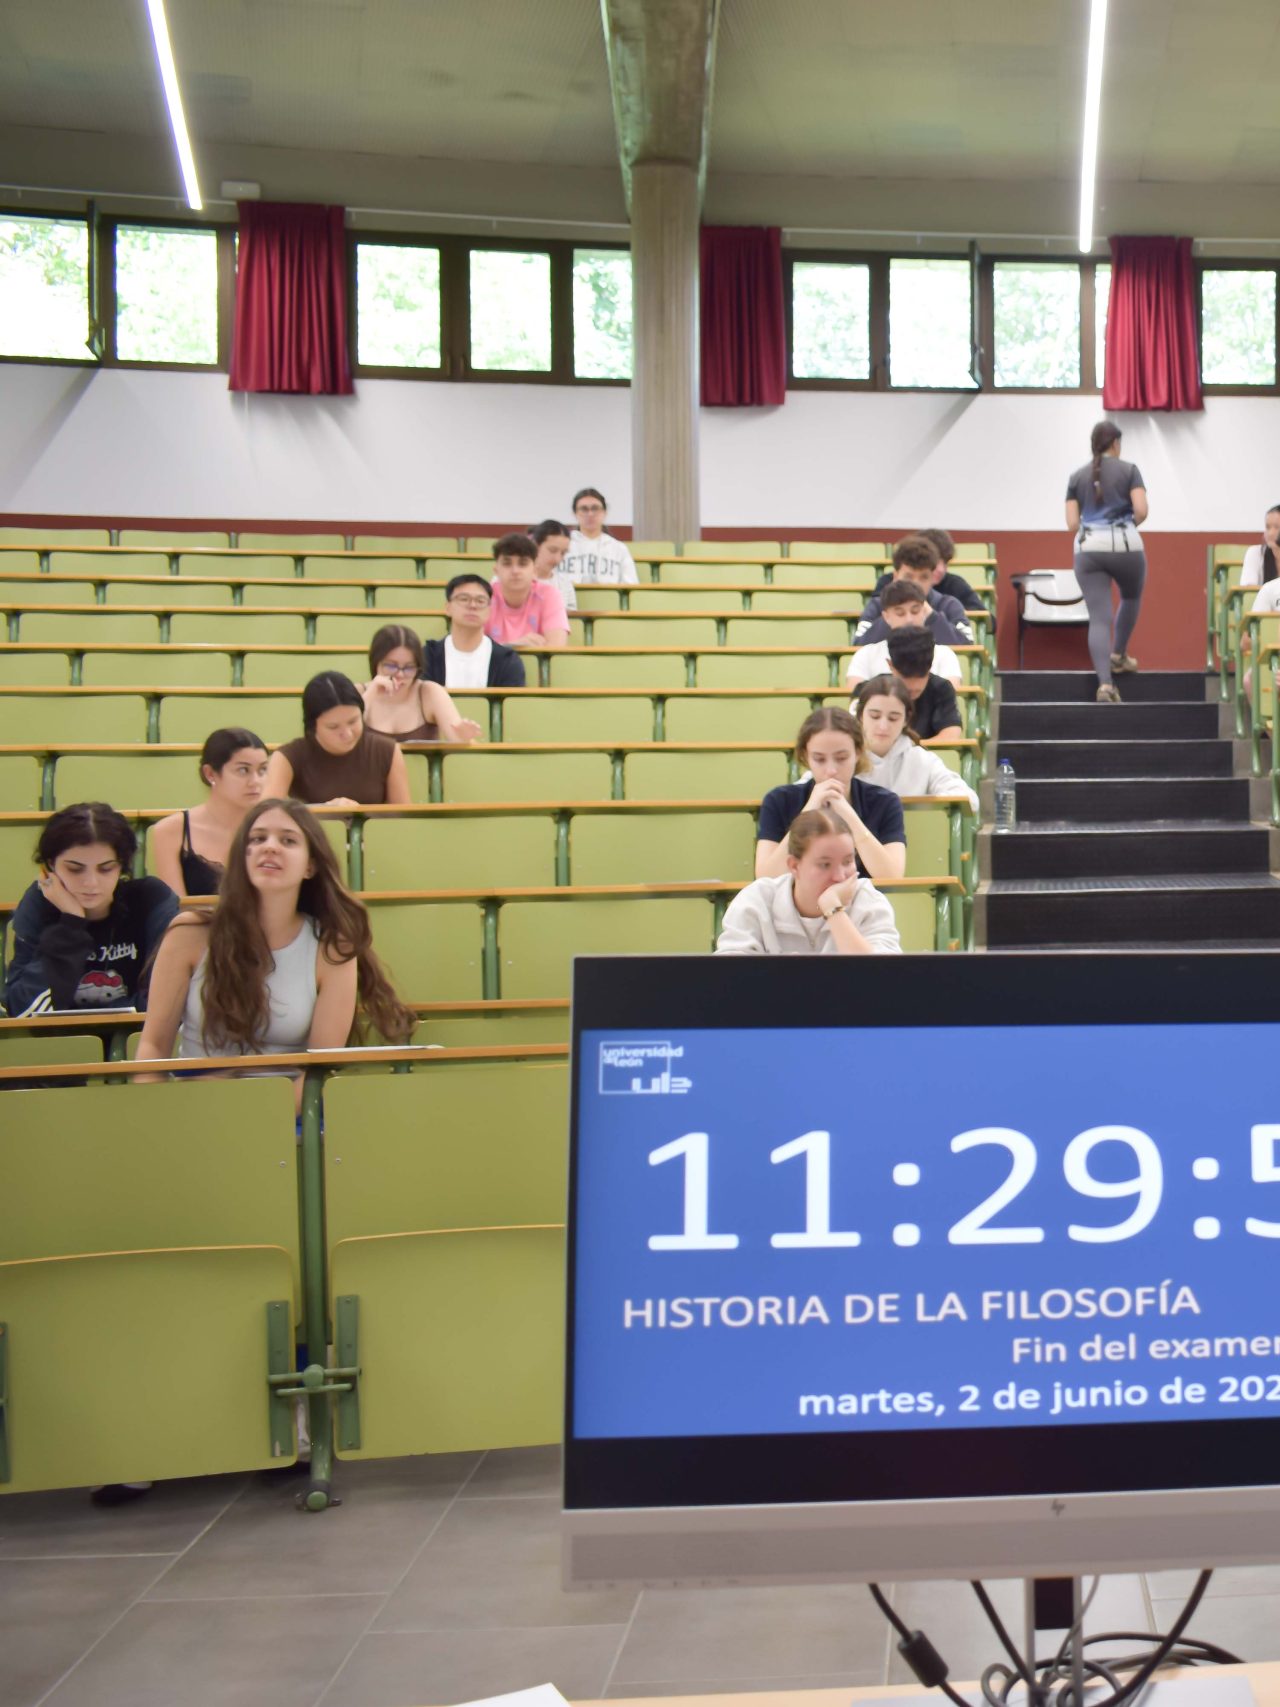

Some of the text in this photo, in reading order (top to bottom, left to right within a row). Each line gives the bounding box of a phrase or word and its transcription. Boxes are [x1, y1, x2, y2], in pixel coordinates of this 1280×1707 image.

[99, 942, 138, 962] Kitty
[603, 1045, 684, 1058] universidad
[623, 1279, 1201, 1329] HISTORIA DE LA FILOSOFÍA
[1012, 1336, 1067, 1364] Fin
[1079, 1332, 1137, 1362] del
[799, 1389, 946, 1417] martes,
[958, 1384, 981, 1412] 2
[992, 1381, 1041, 1411] de
[1049, 1379, 1149, 1415] junio
[1159, 1376, 1207, 1405] de
